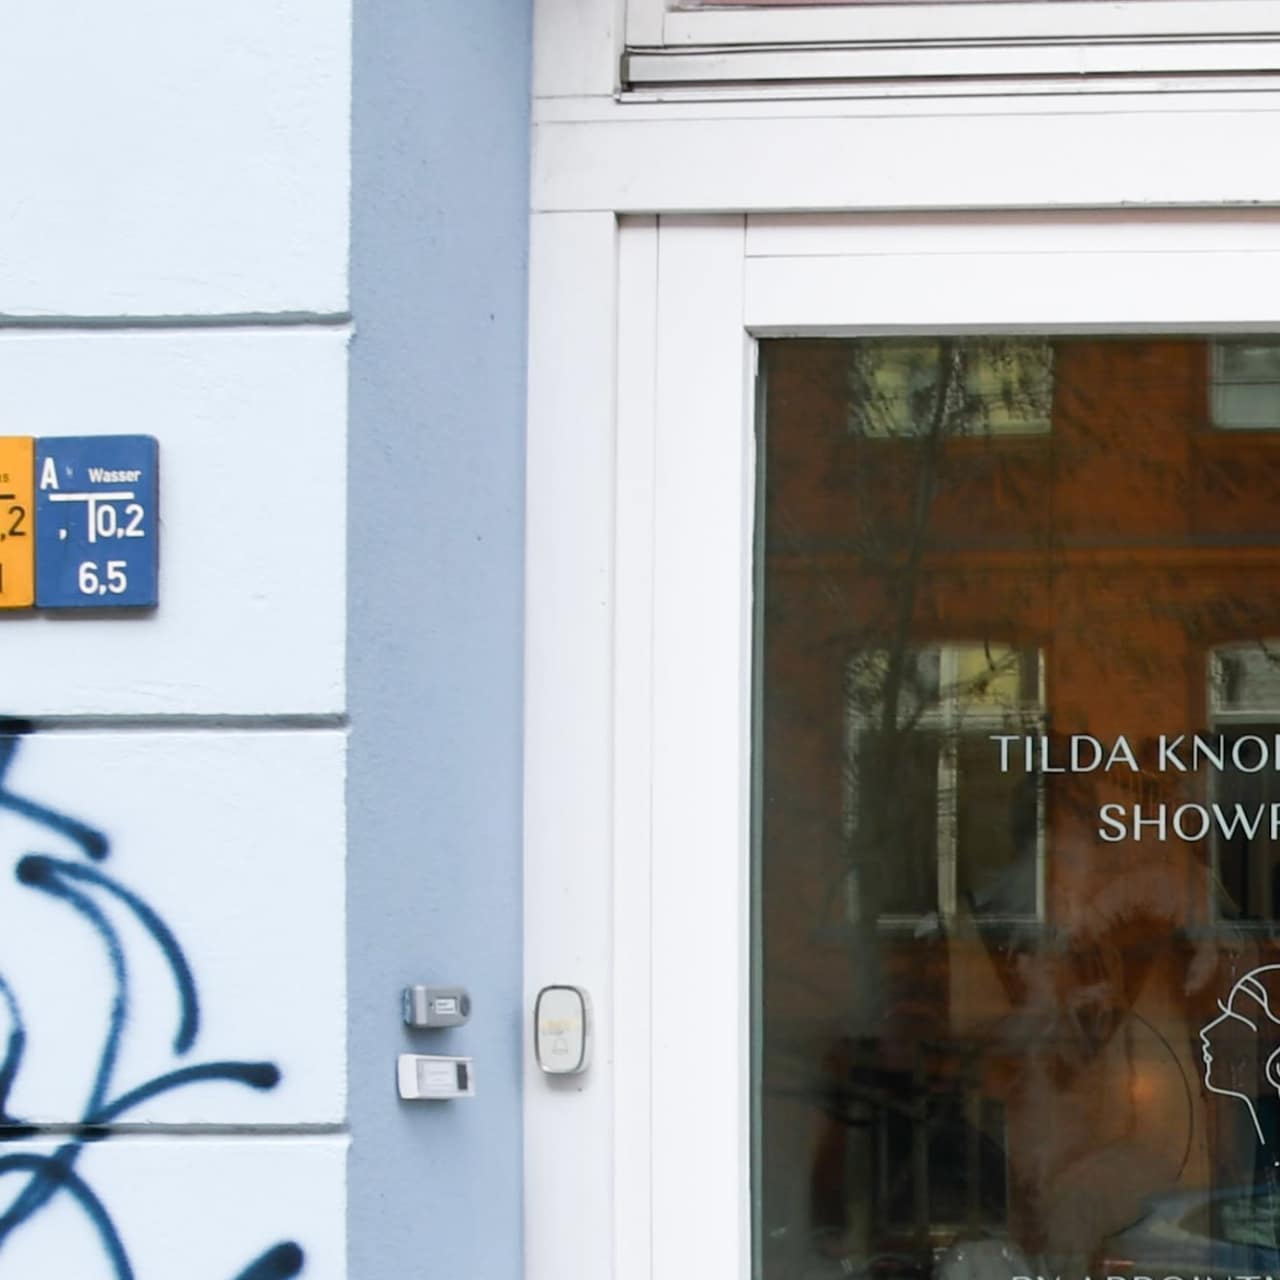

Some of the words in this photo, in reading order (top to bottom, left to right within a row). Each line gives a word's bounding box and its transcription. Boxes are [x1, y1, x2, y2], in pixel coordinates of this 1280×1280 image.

[40, 457, 59, 490] A
[88, 467, 142, 484] Wasser
[78, 560, 127, 595] 6,5
[990, 735, 1140, 773] TILDA
